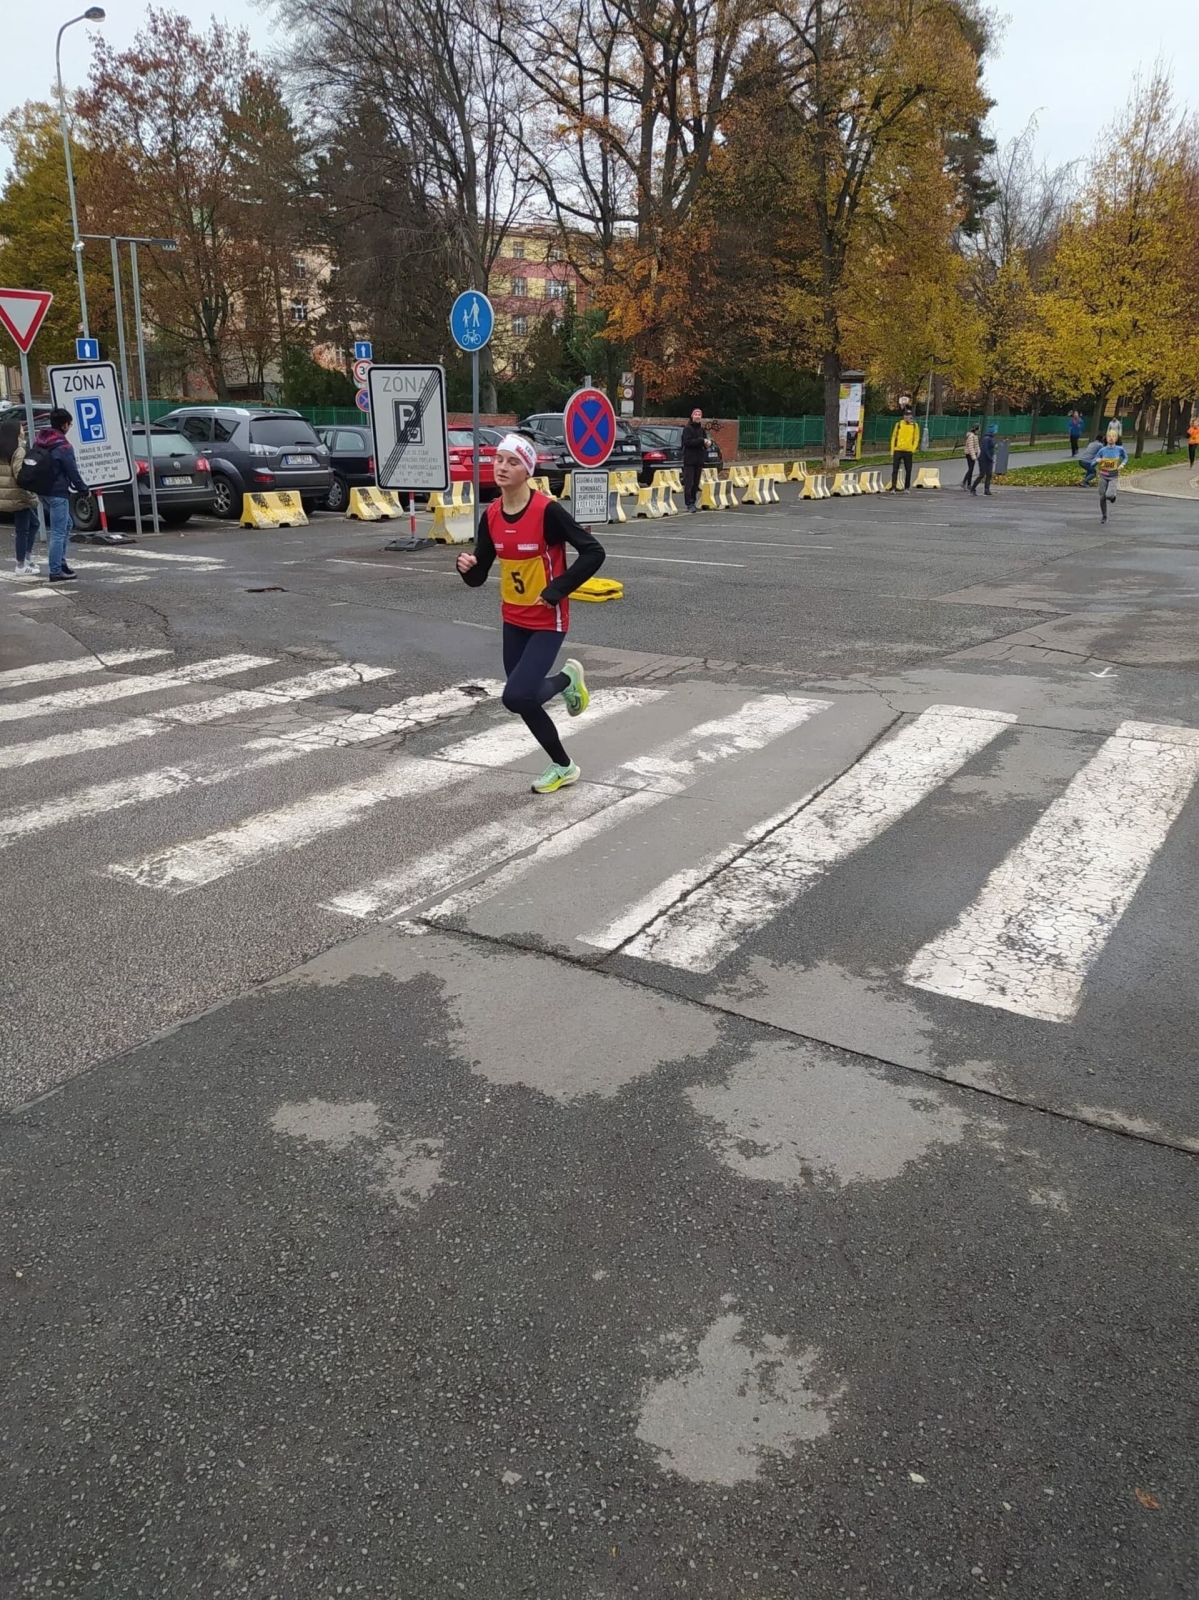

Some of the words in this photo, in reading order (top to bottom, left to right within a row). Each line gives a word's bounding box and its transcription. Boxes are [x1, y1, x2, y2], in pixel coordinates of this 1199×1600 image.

[62, 371, 106, 392] ZÓNA
[80, 402, 97, 430] P
[510, 571, 525, 594] 5
